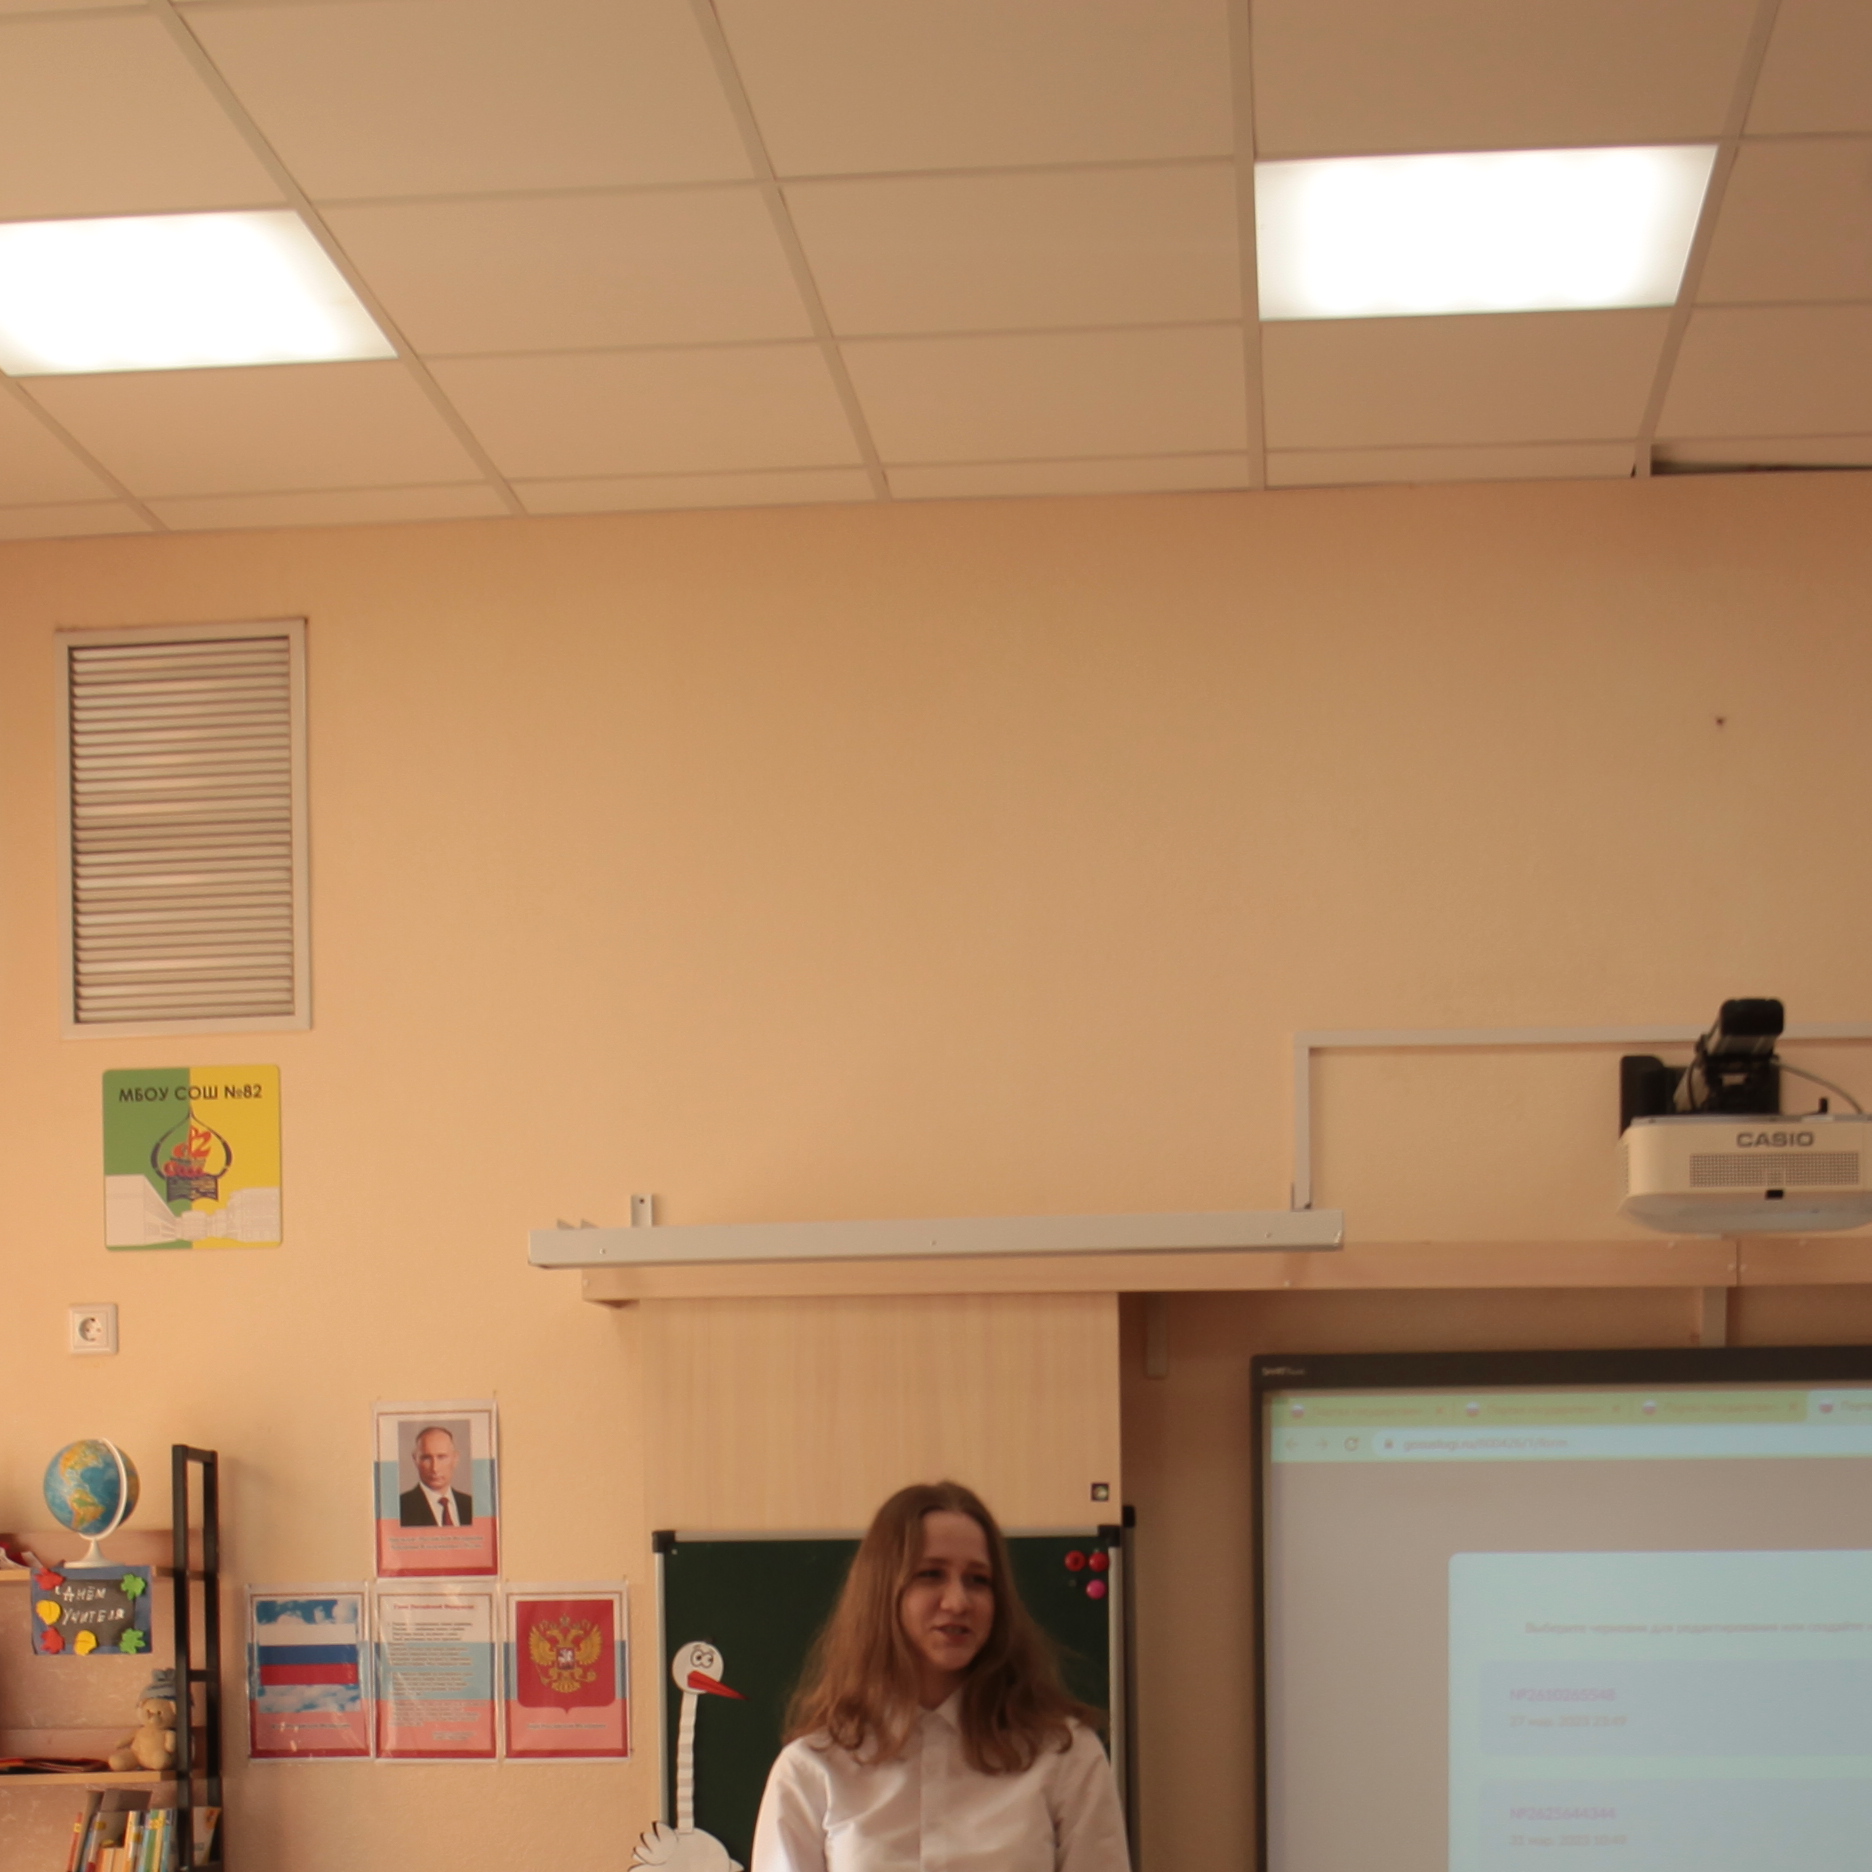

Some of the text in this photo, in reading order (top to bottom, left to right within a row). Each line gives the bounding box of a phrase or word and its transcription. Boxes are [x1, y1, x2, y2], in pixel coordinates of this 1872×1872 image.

[119, 1084, 263, 1102] МБОУ СОШ №82
[1736, 1131, 1815, 1148] CASIO
[61, 1607, 126, 1626] УЧИТЕЛЯ
